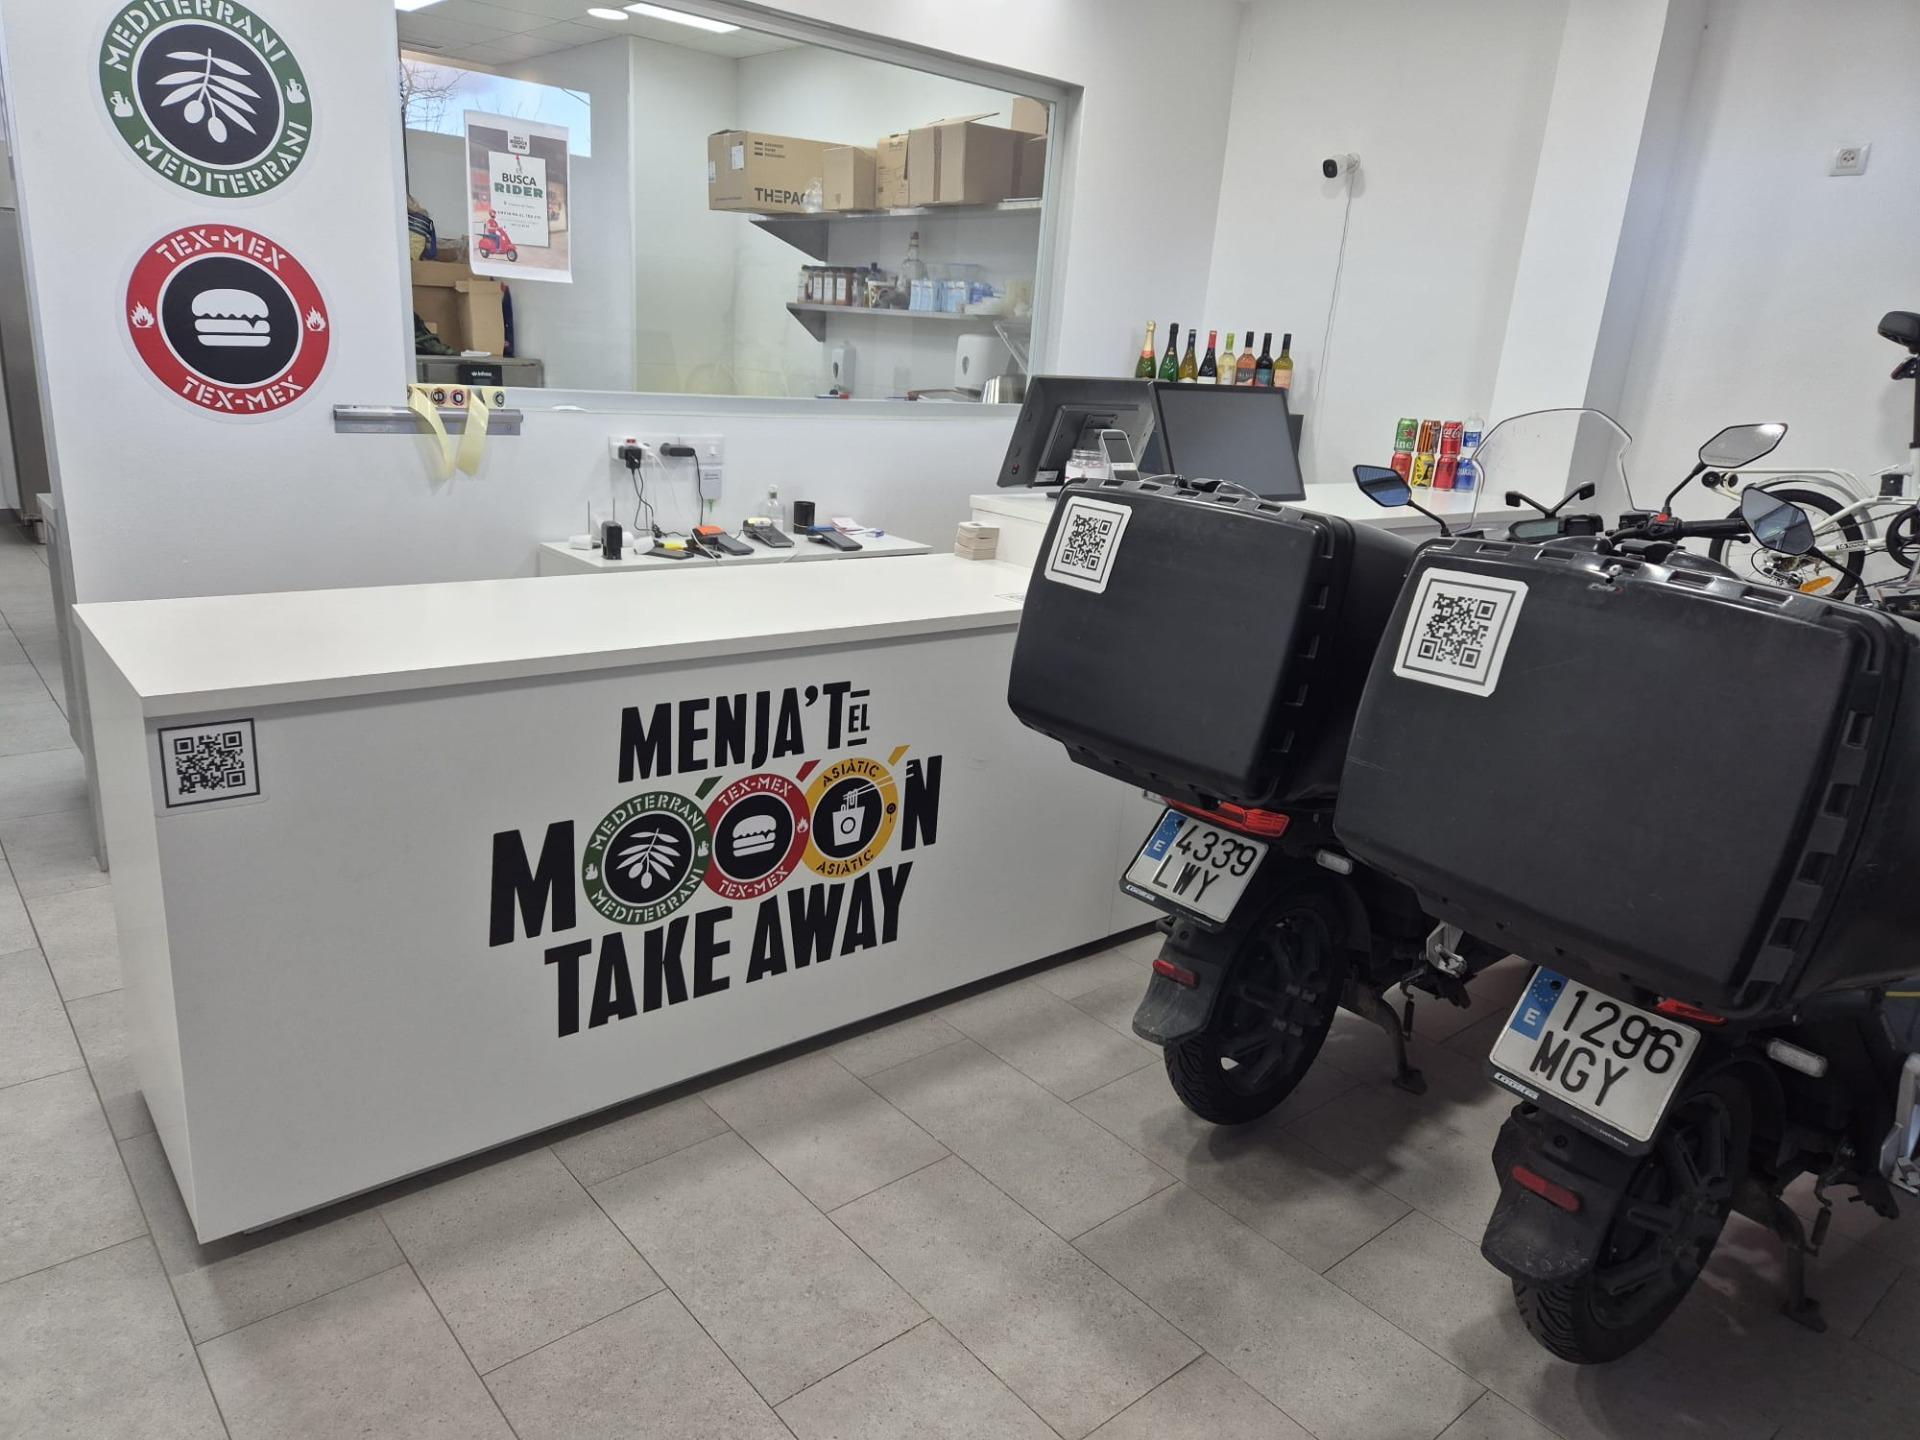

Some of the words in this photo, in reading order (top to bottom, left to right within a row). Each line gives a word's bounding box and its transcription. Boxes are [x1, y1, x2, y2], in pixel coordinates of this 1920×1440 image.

[104, 0, 287, 72] MEDITERRANI
[135, 121, 308, 194] MEDITERRANI
[501, 172, 537, 187] BUSCA
[493, 182, 544, 199] RIDER
[155, 229, 287, 271] TEX-MEX
[181, 375, 304, 412] TEX-MEX
[618, 681, 852, 784] MENJA'T
[847, 703, 871, 733] EL
[718, 775, 794, 807] TEX-MEX
[590, 794, 707, 851] MEDITERRANI
[1152, 841, 1166, 852] E
[1175, 824, 1258, 877] 4339
[590, 868, 705, 923] MEDITERRANI
[718, 865, 789, 898] TEX-MEX
[1152, 855, 1220, 903] LWY
[544, 905, 733, 1038] TAKE
[746, 861, 914, 984] AWAY
[1523, 1007, 1541, 1026] E
[1562, 990, 1684, 1074] 1296
[1529, 1031, 1630, 1107] MGY
